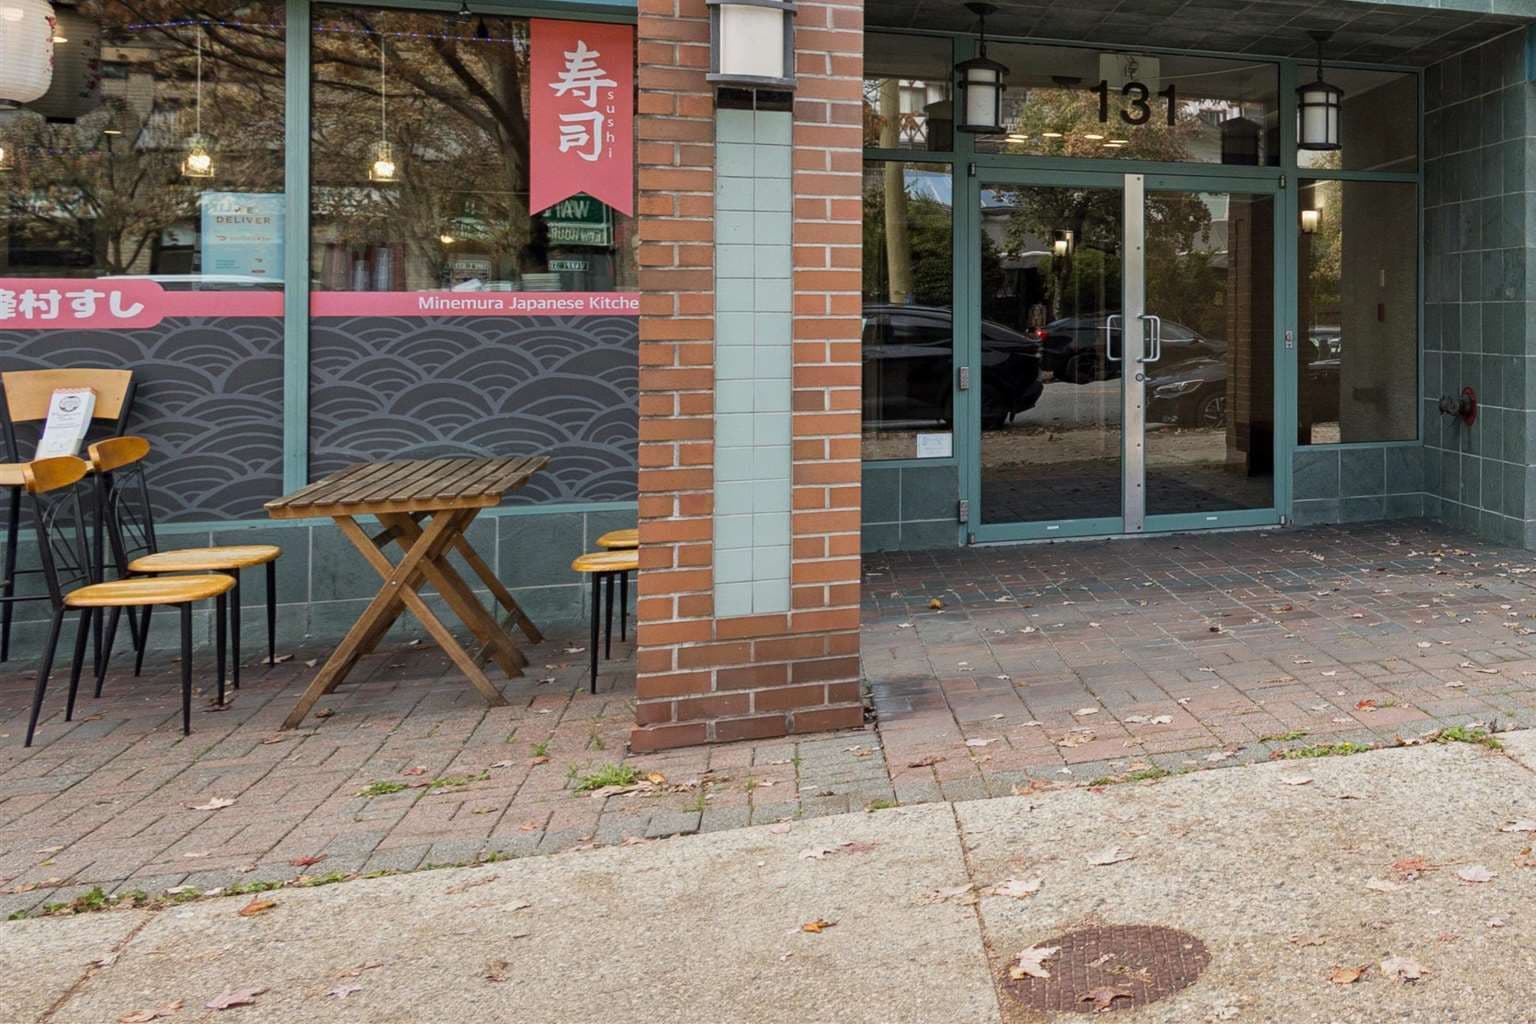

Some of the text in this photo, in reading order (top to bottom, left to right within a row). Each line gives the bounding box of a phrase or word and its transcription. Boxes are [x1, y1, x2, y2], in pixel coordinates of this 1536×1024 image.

[549, 39, 617, 161] 寿司
[1090, 79, 1175, 126] 131
[605, 90, 616, 159] sushi
[216, 216, 271, 225] DELIVER
[418, 296, 639, 312] Minemura Japanese Kitche
